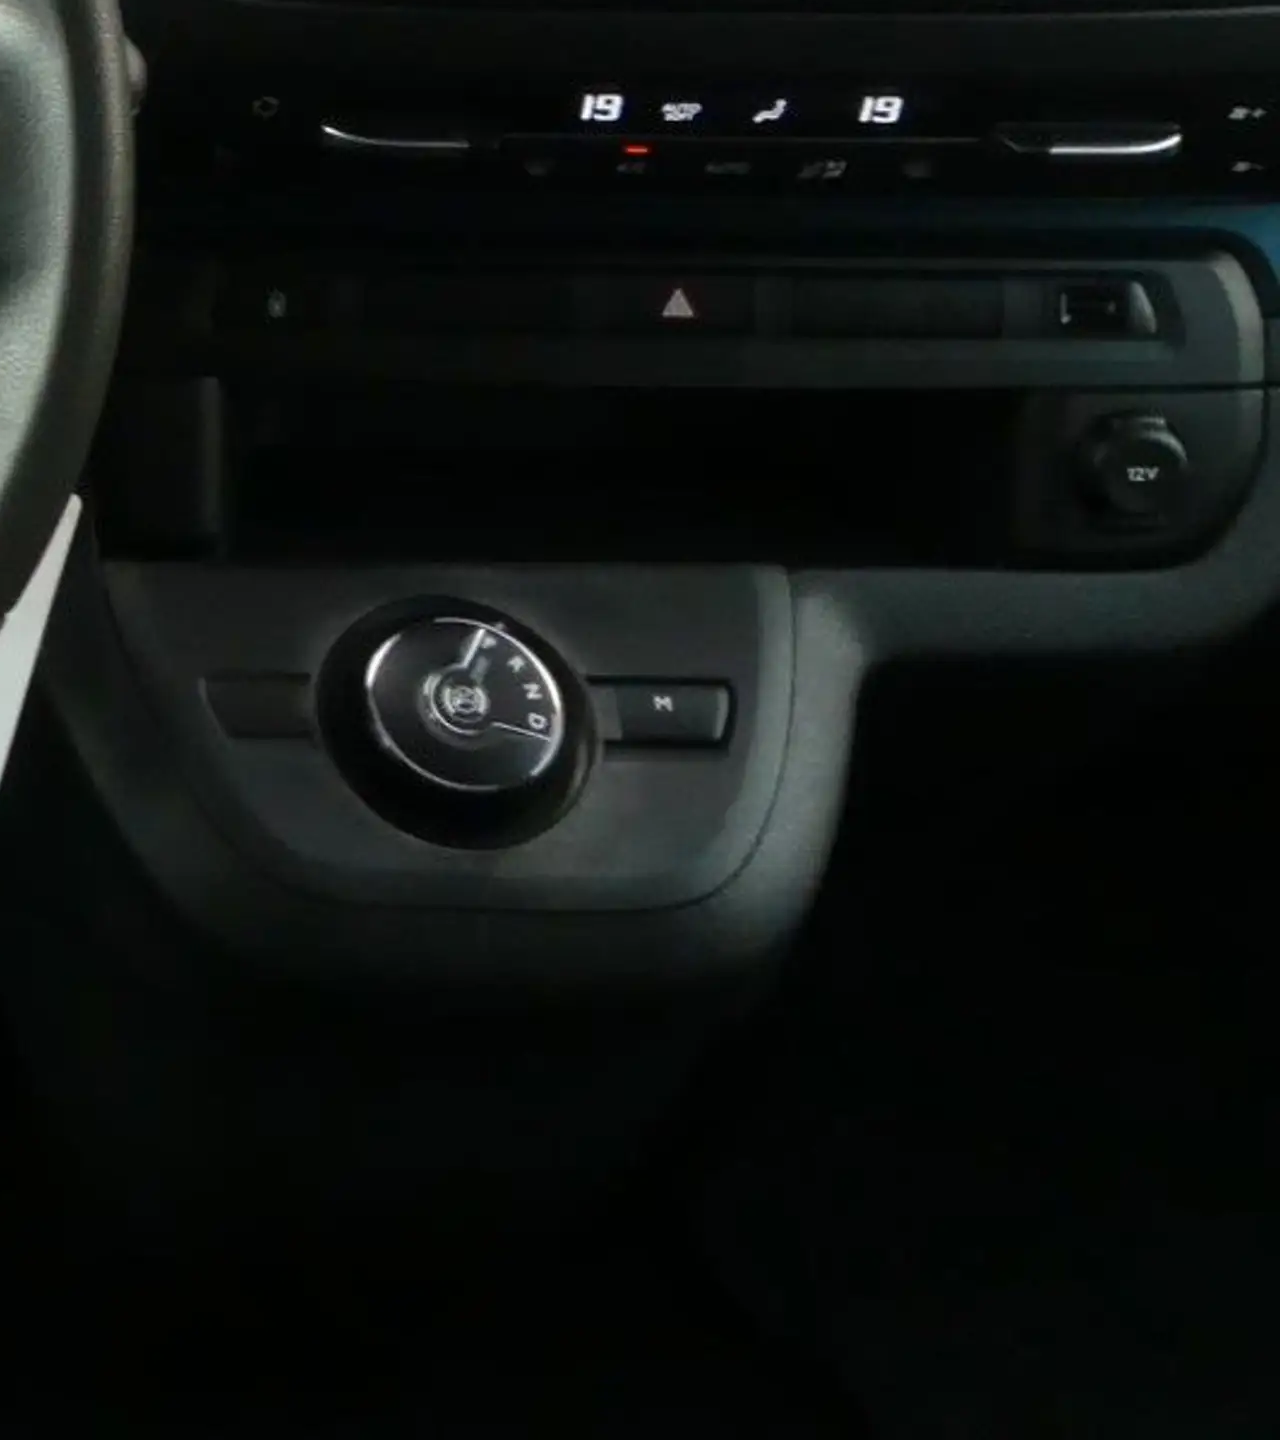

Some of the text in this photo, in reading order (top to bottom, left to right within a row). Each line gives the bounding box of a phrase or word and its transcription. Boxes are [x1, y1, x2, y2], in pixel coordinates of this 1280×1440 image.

[579, 92, 624, 121] 19
[857, 95, 905, 124] 19
[1126, 465, 1161, 482] 12V
[522, 682, 544, 700] N
